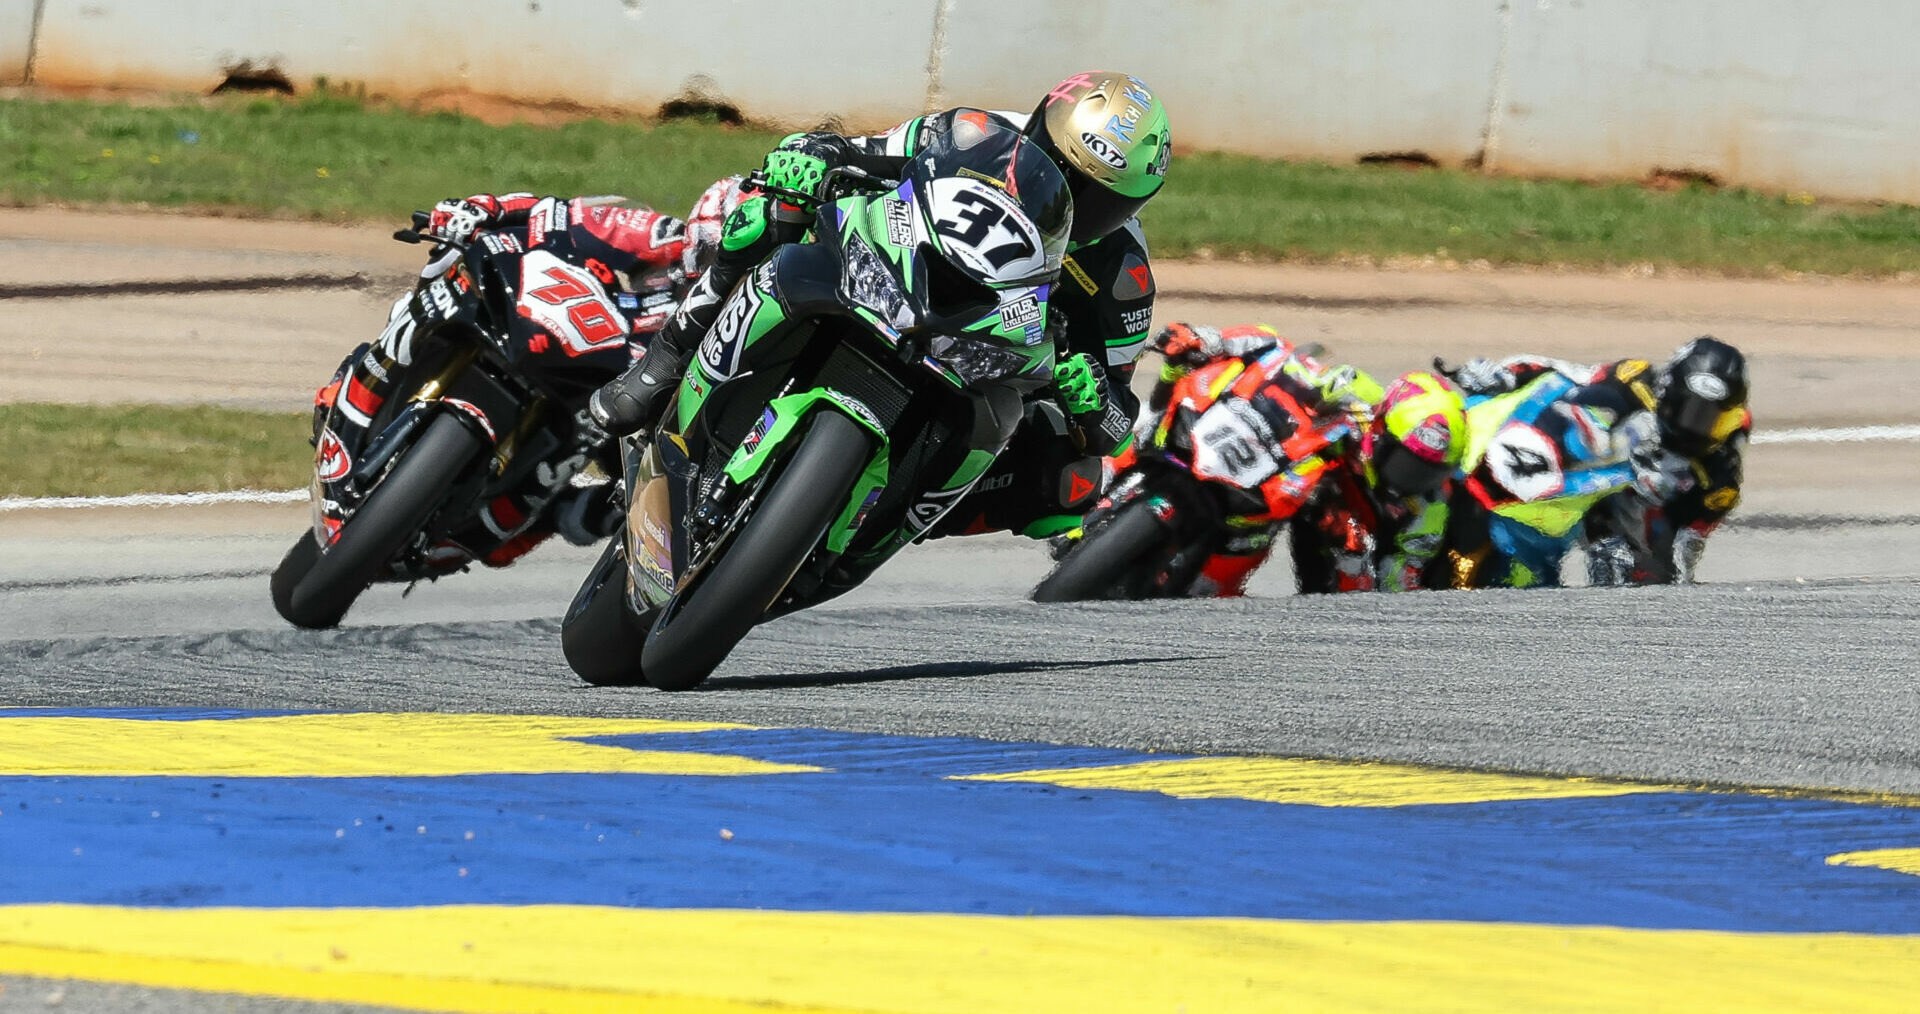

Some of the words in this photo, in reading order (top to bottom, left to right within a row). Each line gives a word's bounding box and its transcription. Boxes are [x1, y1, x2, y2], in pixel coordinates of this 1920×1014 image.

[1082, 133, 1126, 166] KYT
[935, 189, 1036, 271] 37
[1067, 261, 1095, 292] DUNLOP
[527, 266, 623, 345] 70
[1004, 316, 1022, 329] CYCLE
[1501, 443, 1550, 478] 4
